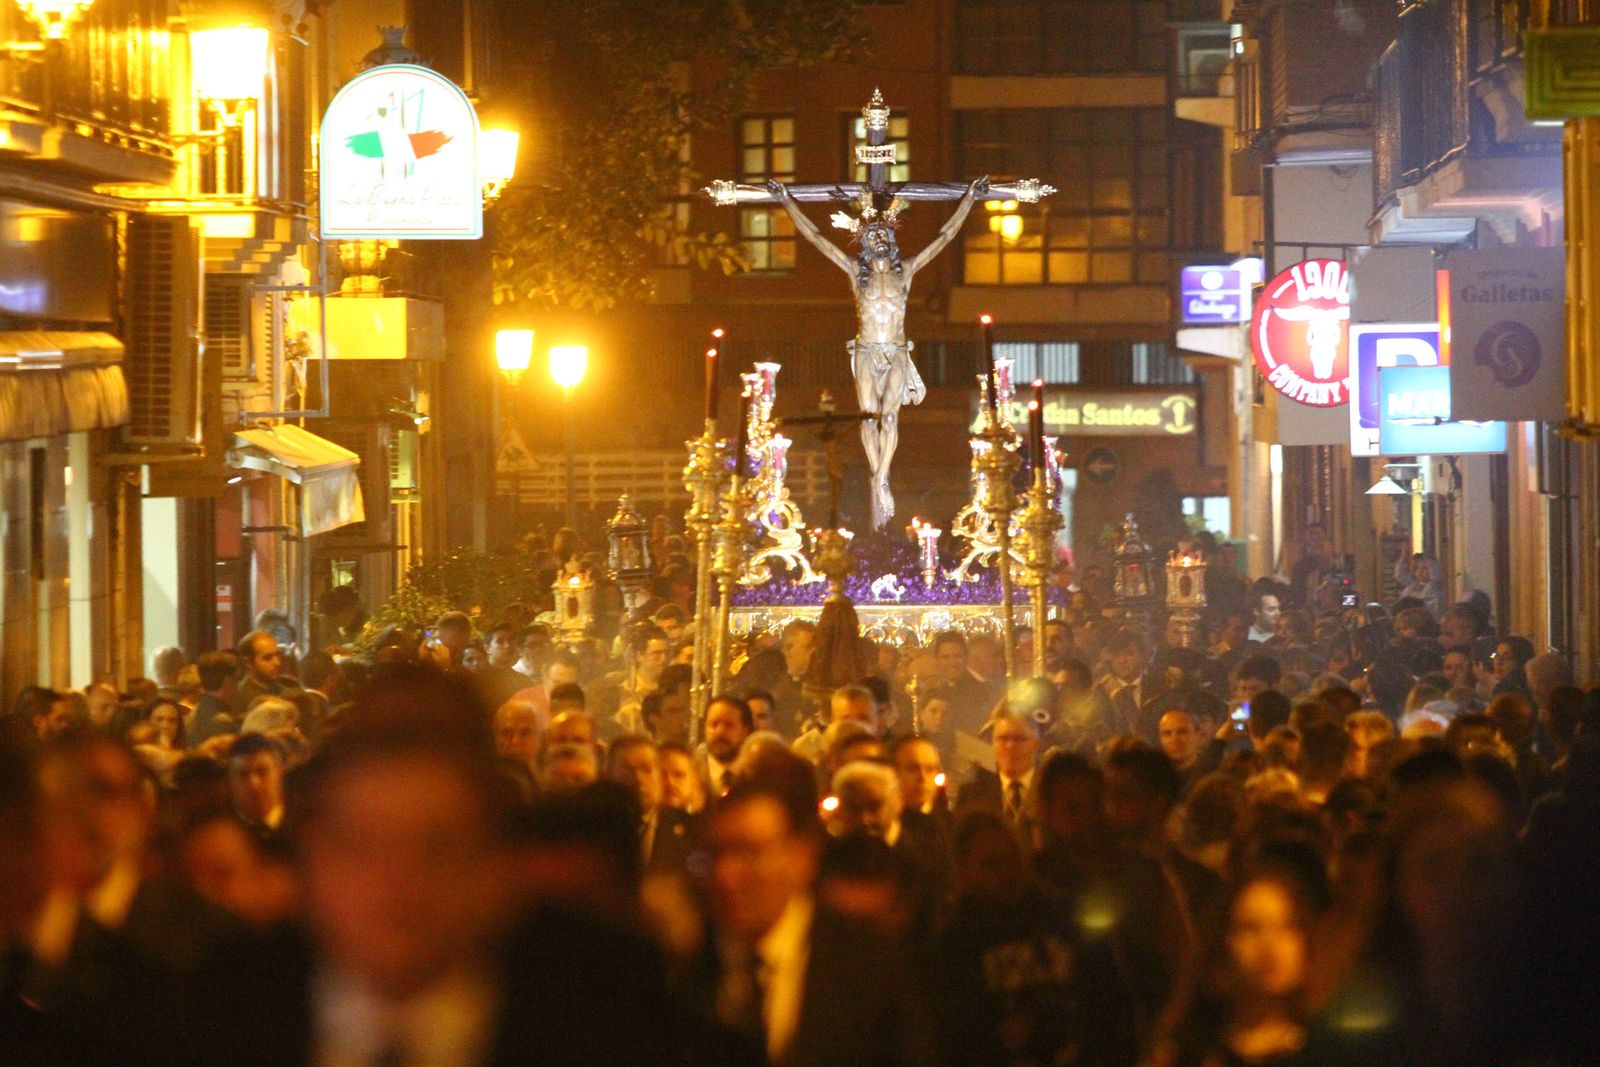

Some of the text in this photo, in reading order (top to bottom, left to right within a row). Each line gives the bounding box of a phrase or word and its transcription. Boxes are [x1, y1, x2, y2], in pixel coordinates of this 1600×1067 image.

[1461, 283, 1554, 303] Galletas
[1268, 364, 1341, 405] COMPANY
[1082, 402, 1161, 425] Santos
